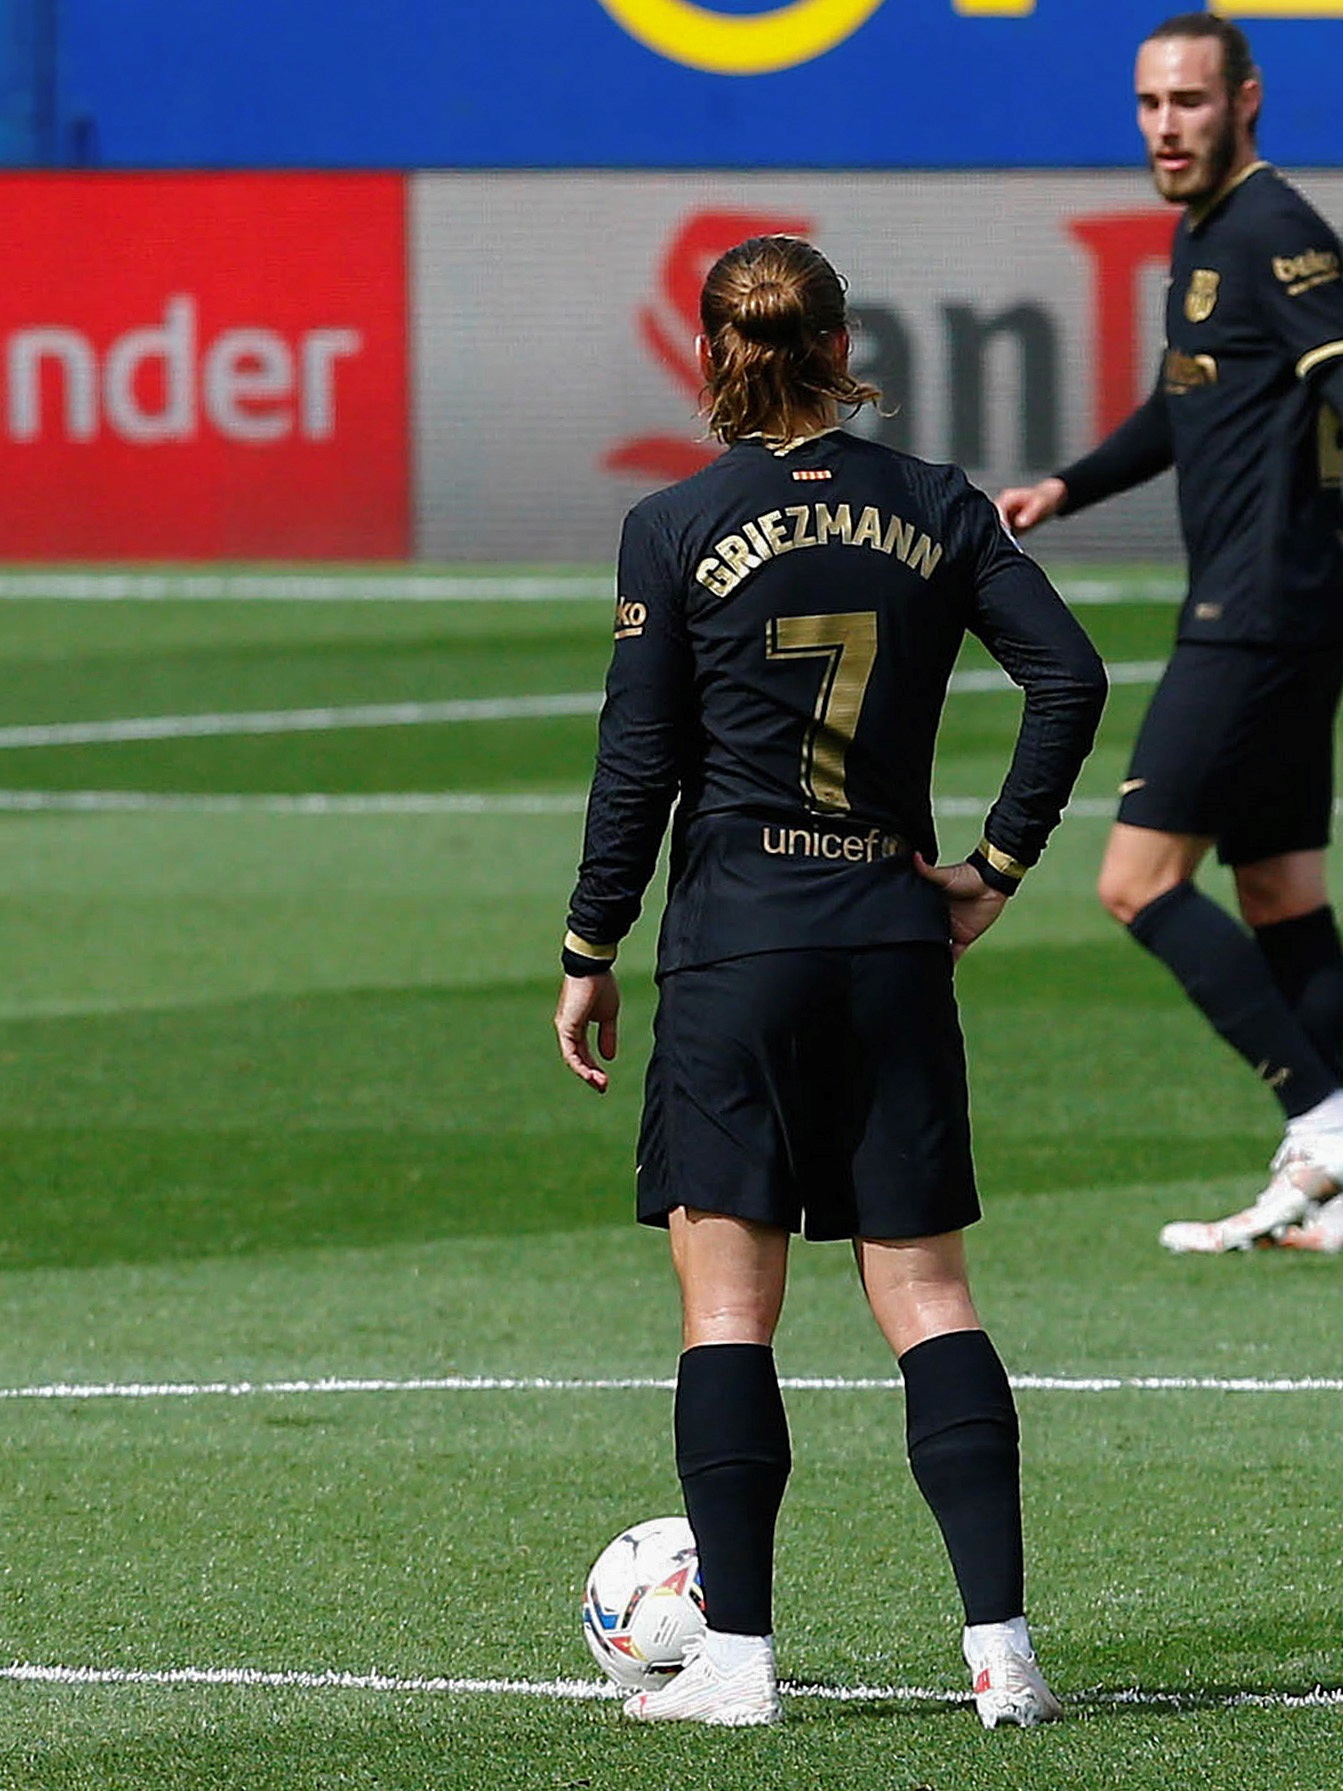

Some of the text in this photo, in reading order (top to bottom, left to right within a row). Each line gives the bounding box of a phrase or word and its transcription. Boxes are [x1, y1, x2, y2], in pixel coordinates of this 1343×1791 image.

[696, 502, 942, 598] GRIEZMANN
[765, 610, 878, 817] 7
[762, 824, 880, 864] unicef
